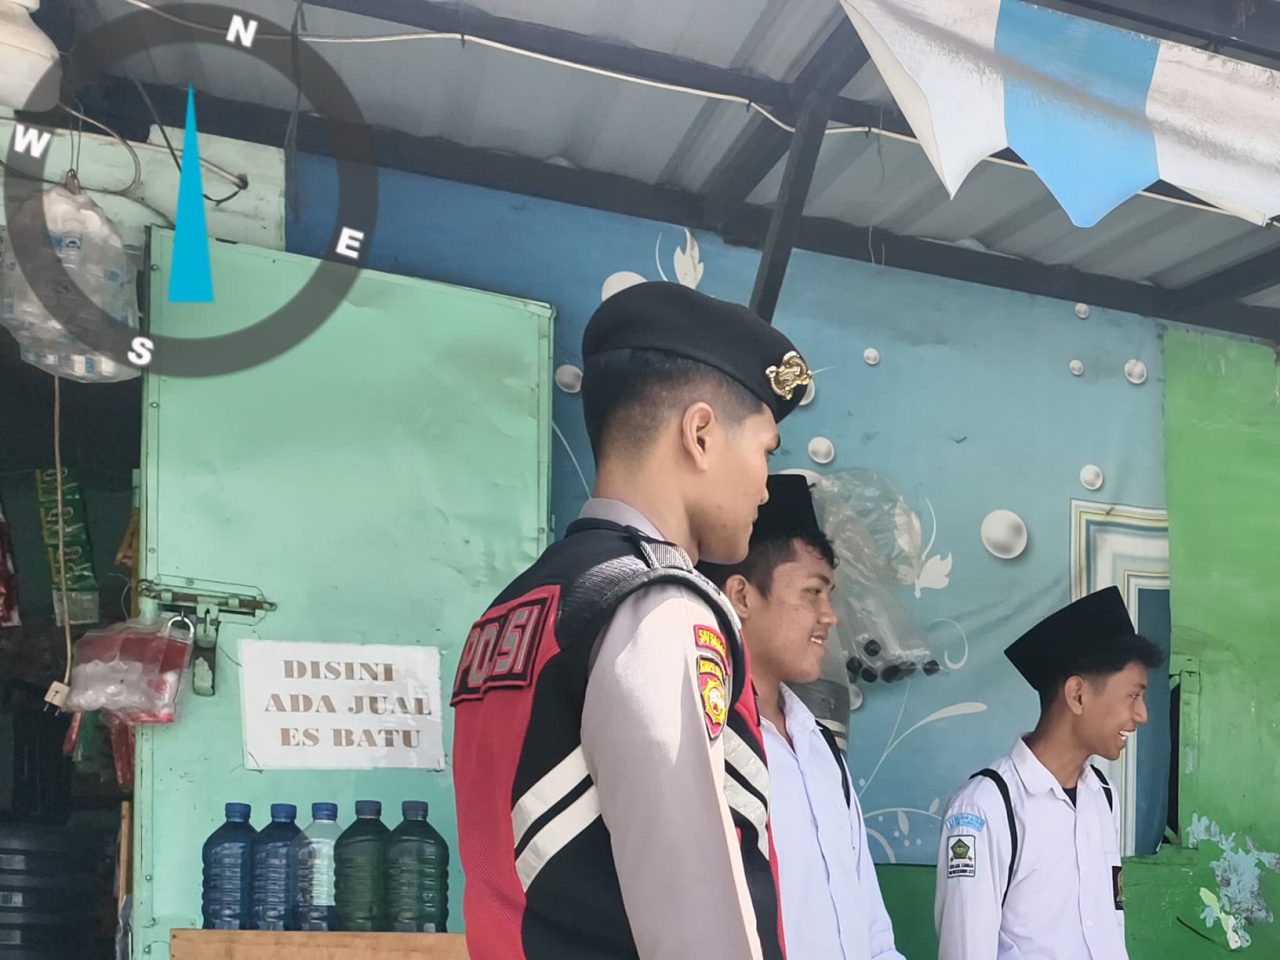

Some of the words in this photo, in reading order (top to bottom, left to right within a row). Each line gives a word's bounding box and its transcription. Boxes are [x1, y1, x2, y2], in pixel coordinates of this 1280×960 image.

[283, 659, 395, 682] DISINI
[264, 693, 337, 714] ADA
[347, 696, 432, 715] JUAL
[280, 727, 320, 747] ES
[330, 728, 422, 749] BATU
